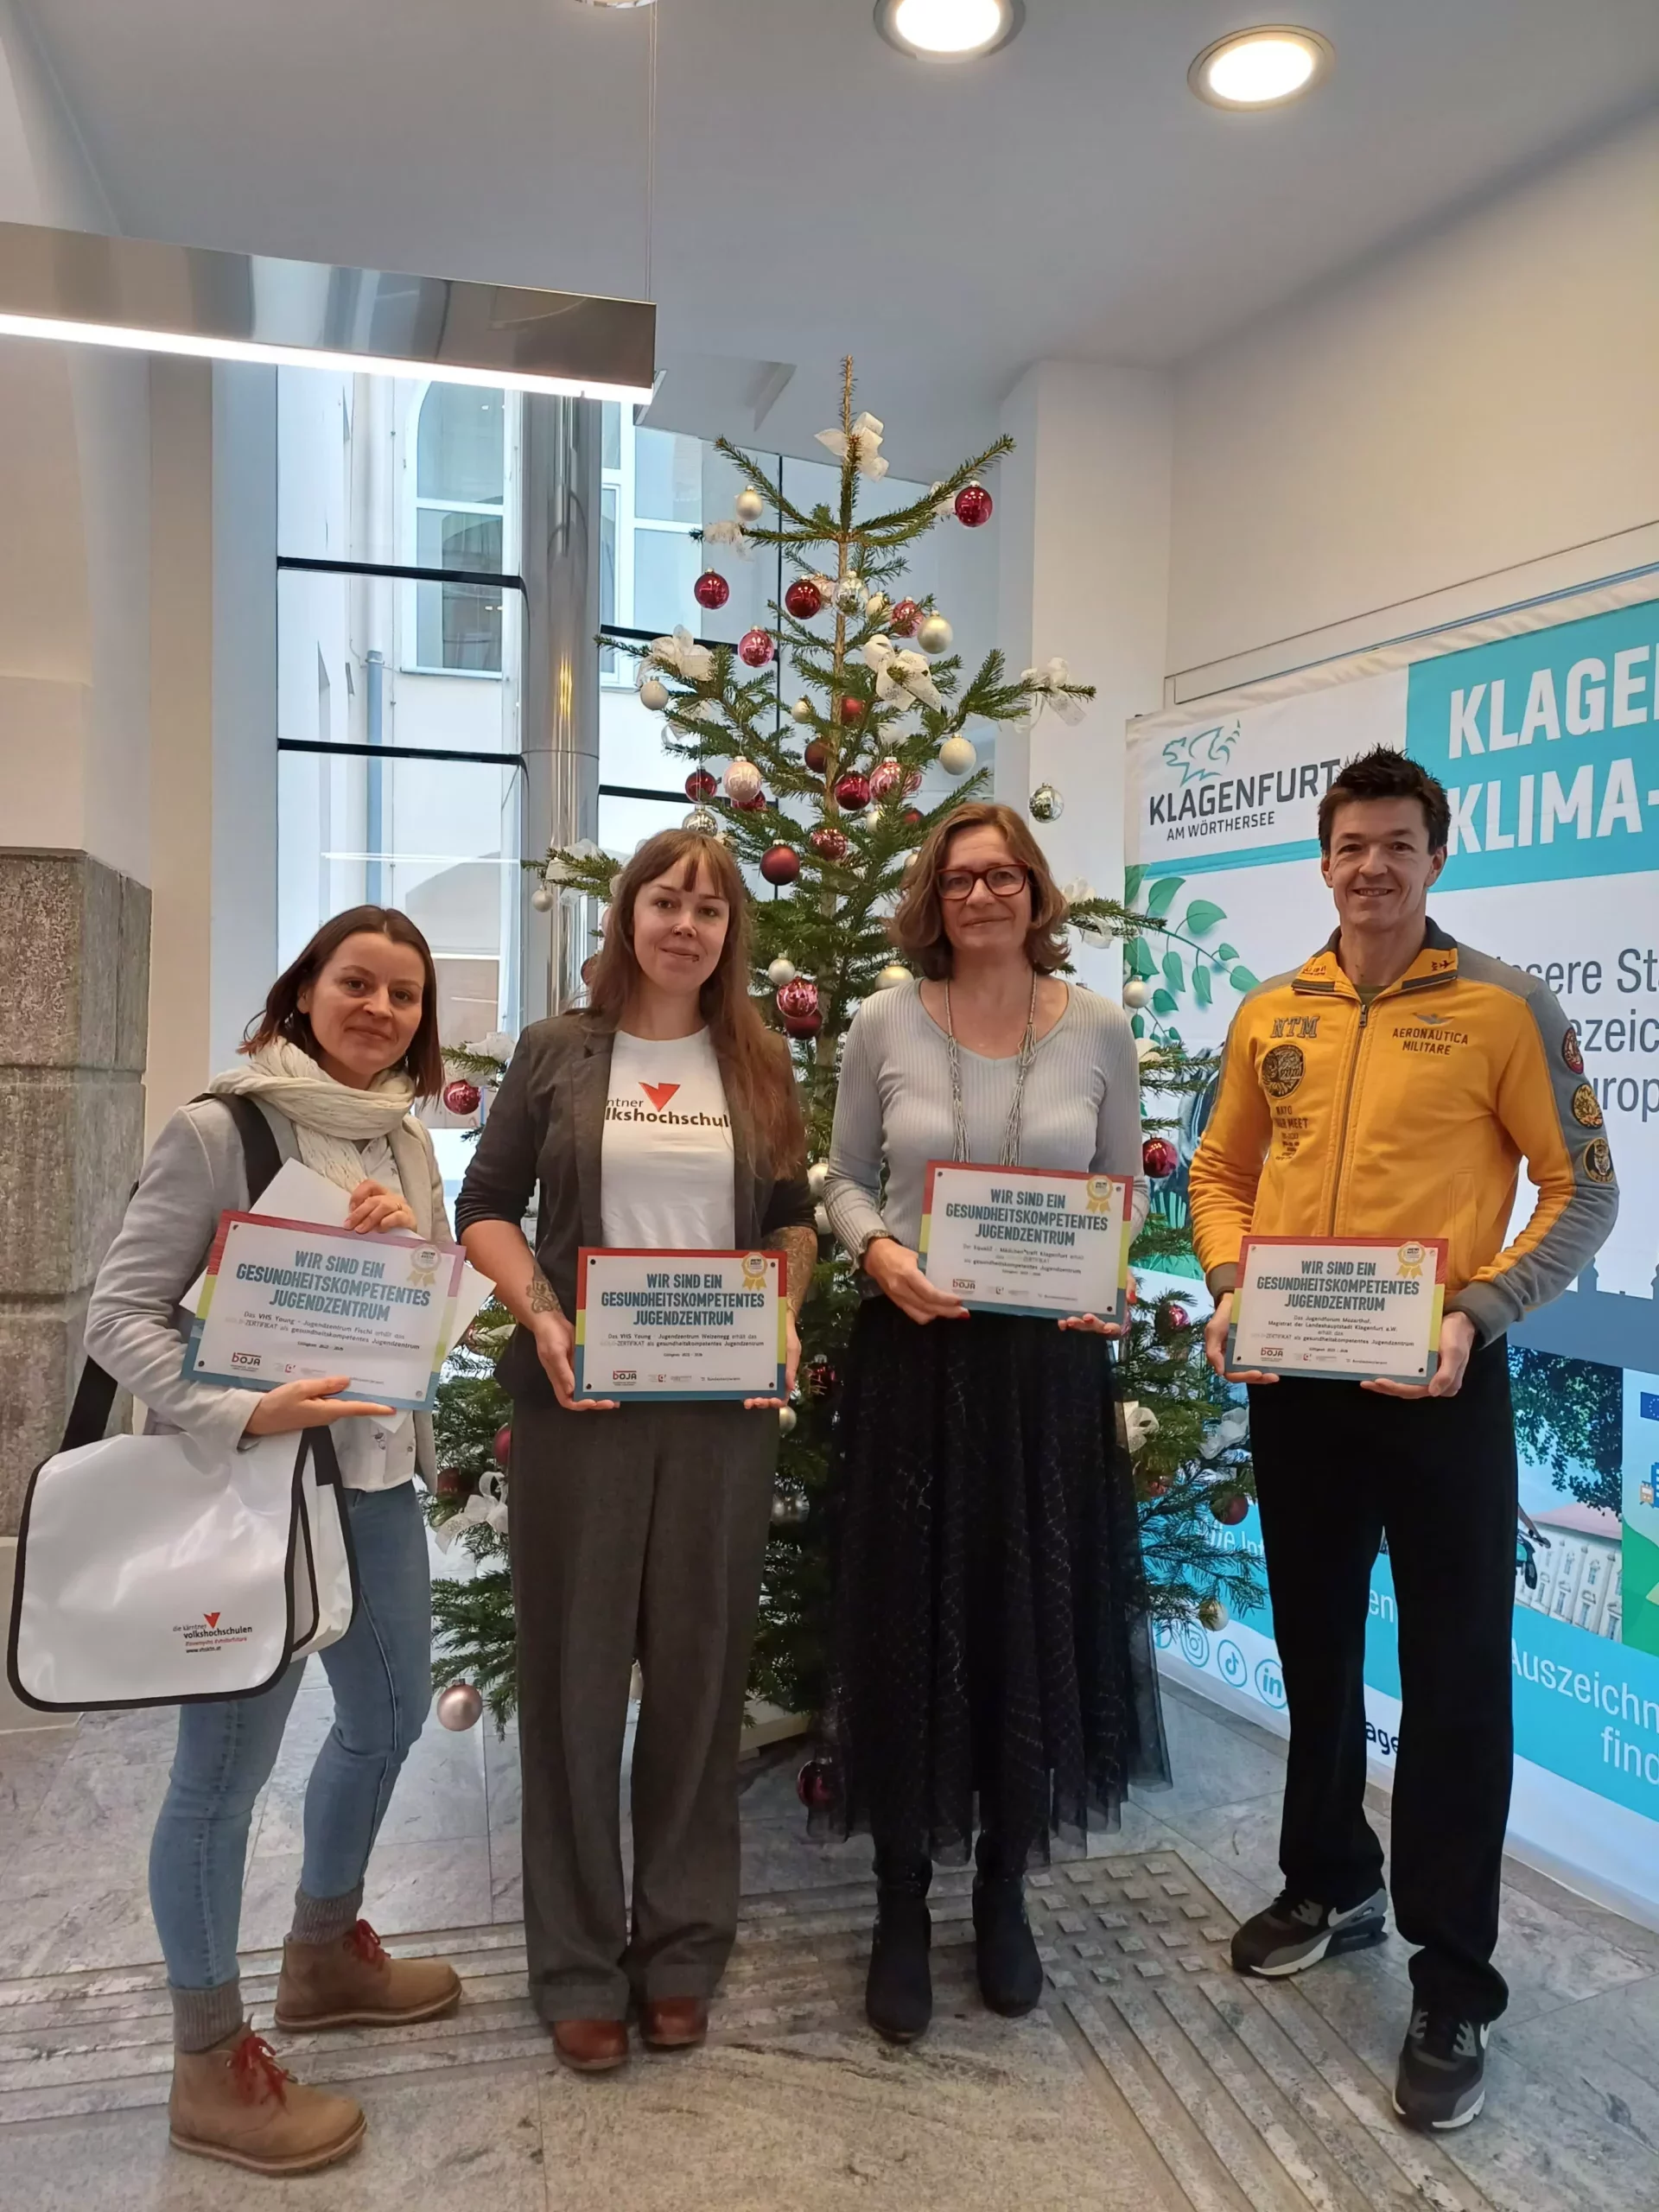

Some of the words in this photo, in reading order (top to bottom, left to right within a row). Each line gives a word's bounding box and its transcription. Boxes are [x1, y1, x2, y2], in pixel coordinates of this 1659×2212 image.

[1150, 759, 1340, 825] KLAGENFURT
[1447, 758, 1659, 855] KLIMA-
[1166, 826, 1185, 842] AM
[1188, 811, 1275, 837] WÖRTHERSEE
[1618, 948, 1659, 993] St
[1270, 1015, 1319, 1039] NTM
[1393, 1028, 1468, 1045] AERONAUTICA
[1402, 1040, 1451, 1055] MILITARE
[990, 1189, 1013, 1205] WIR
[1016, 1192, 1044, 1207] SIND
[1046, 1194, 1065, 1209] EIN
[945, 1203, 1108, 1231] GESUNDHEITSKOMPETENTES
[975, 1224, 1075, 1246] JUGENDZENTRUM
[295, 1250, 321, 1269] WIR
[326, 1255, 358, 1275] SIND
[361, 1261, 385, 1278] EIN
[1301, 1261, 1323, 1274] WIR
[1327, 1262, 1354, 1276] SIND
[1357, 1262, 1376, 1276] EIN
[236, 1263, 430, 1306] GESUNDHEITSKOMPETENTES
[646, 1274, 671, 1289] WIR
[674, 1274, 701, 1289] SIND
[703, 1274, 722, 1289] EIN
[1256, 1276, 1420, 1296] GESUNDHEITSKOMPETENTES
[270, 1290, 391, 1322] JUGENDZENTRUM
[601, 1292, 765, 1307] GESUNDHEITSKOMPETENTES
[1285, 1294, 1385, 1312] JUGENDZENTRUM
[276, 1316, 295, 1325] Young
[303, 1320, 352, 1332] Jugendzentrum
[633, 1311, 734, 1325] JUGENDZENTRUM
[291, 1327, 369, 1343] gesundheitskompetentes
[372, 1338, 420, 1350] Jugendzentrum
[1303, 1336, 1370, 1344] gesundheitskompetentes
[183, 1625, 253, 1639] volkshochschulen
